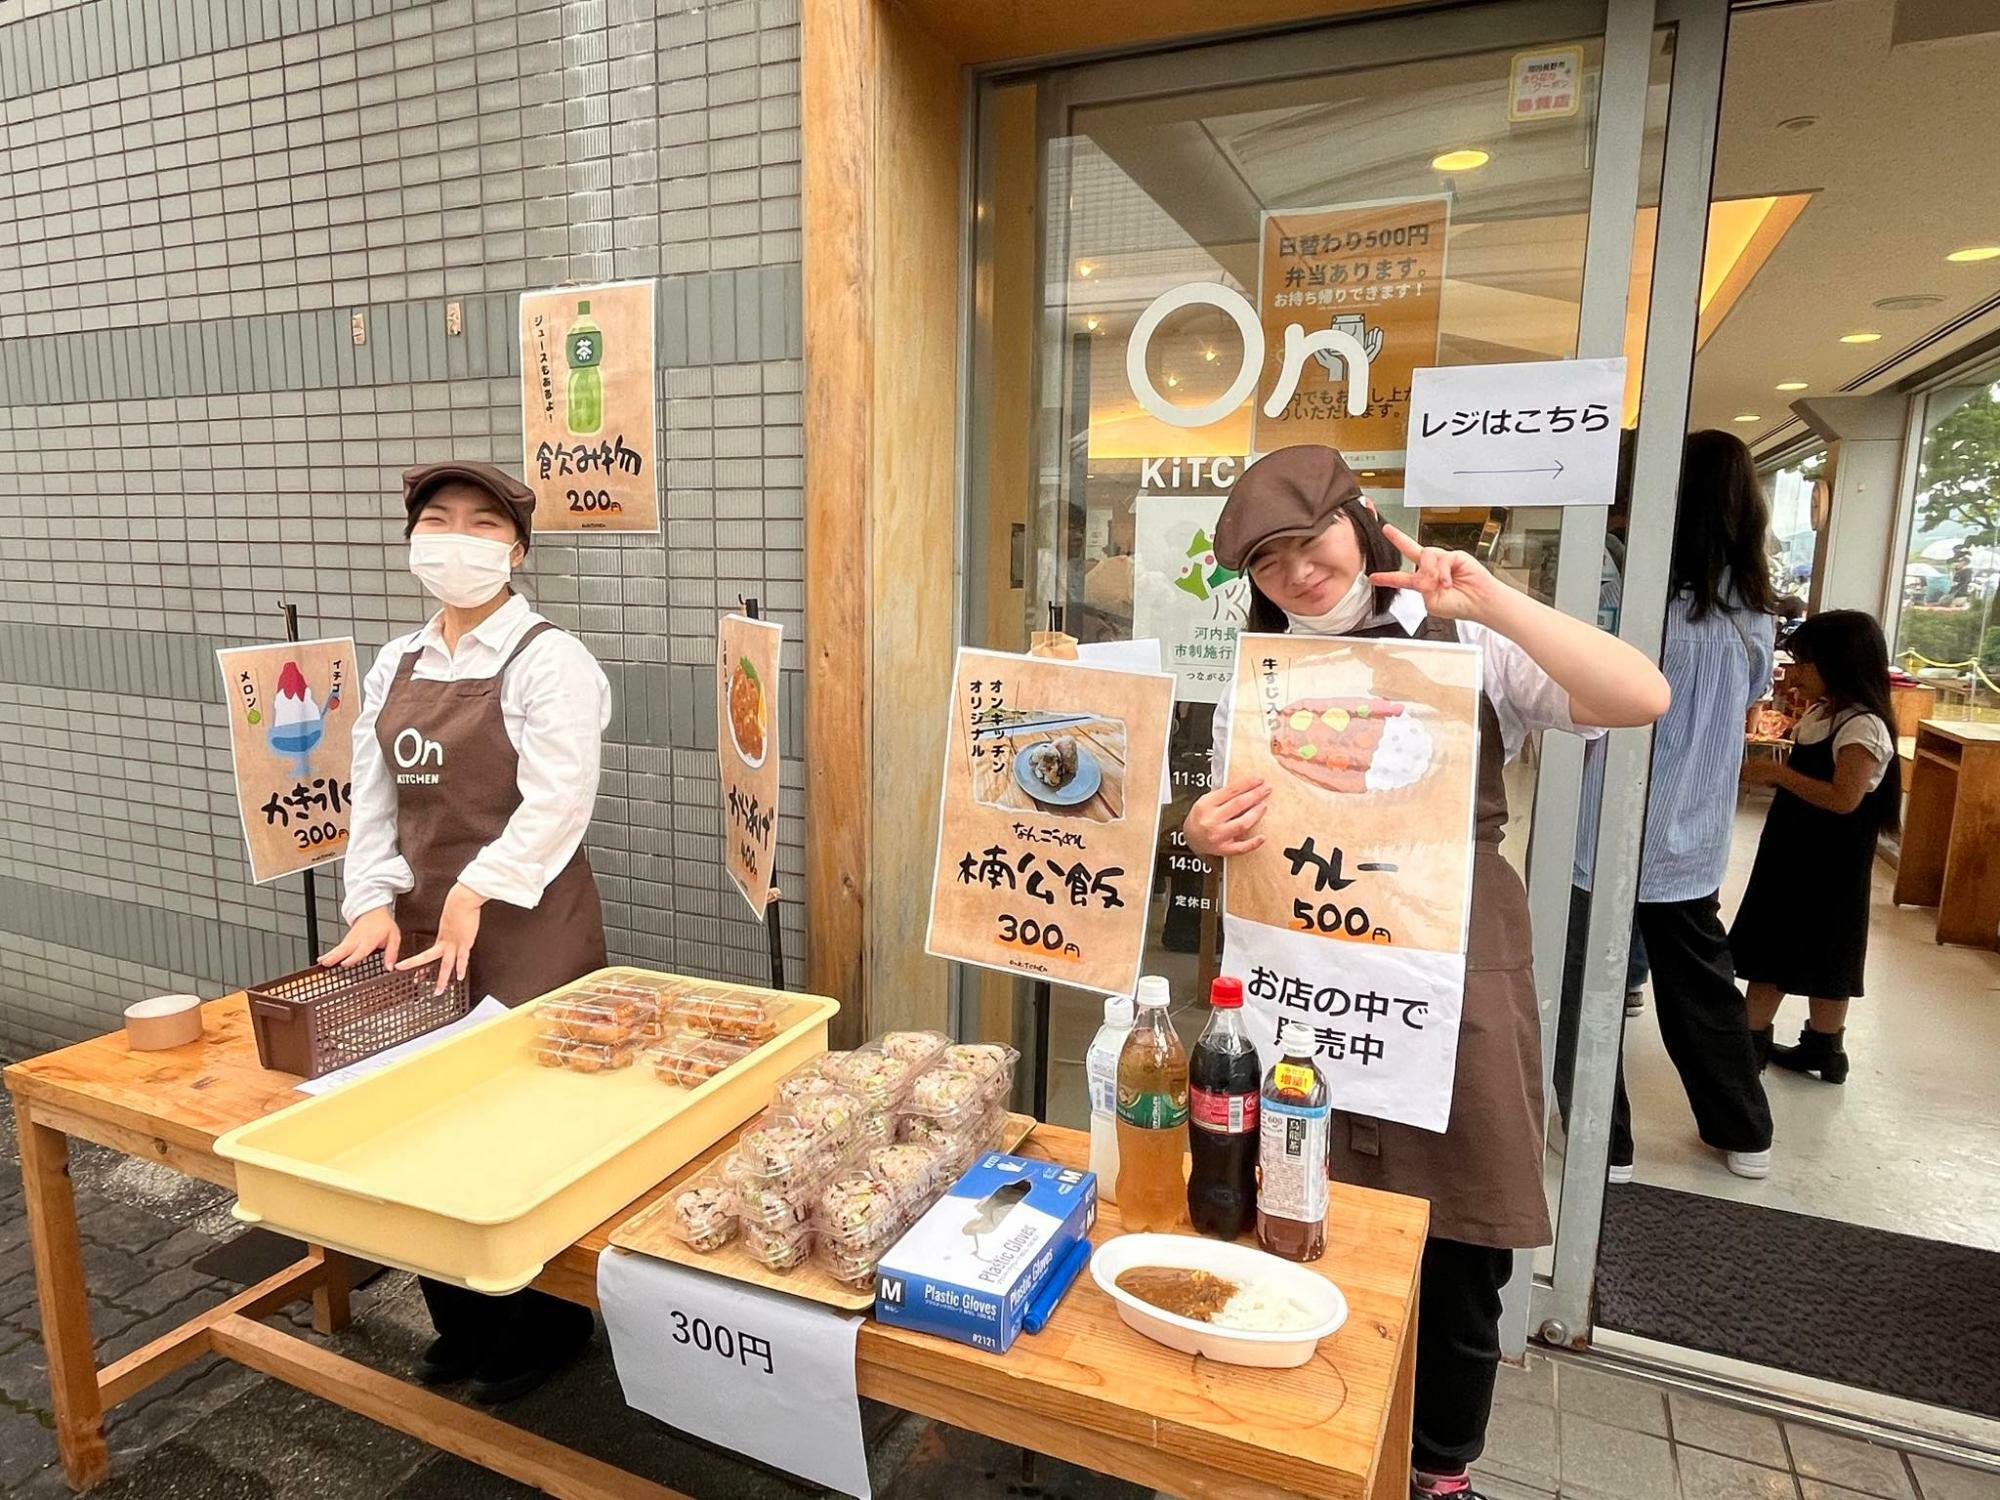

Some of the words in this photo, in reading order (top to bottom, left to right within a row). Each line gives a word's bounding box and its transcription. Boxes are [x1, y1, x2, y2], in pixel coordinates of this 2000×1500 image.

[1279, 224, 1429, 257] 日替わり500円
[1285, 256, 1426, 288] 弁当あります。
[574, 337, 593, 362] 茶
[1127, 281, 1369, 428] On
[1422, 404, 1610, 438] レジはこちら
[536, 434, 642, 481] 飲み物
[566, 489, 623, 513] 200円
[239, 670, 257, 709] メロン
[332, 659, 342, 694] イチゴ
[969, 680, 986, 758] オリジナル
[989, 680, 1006, 774] オンキッチン
[394, 727, 443, 768] On
[294, 821, 349, 848] 300円
[956, 845, 1125, 908] 楠公飯
[1283, 836, 1399, 892] カレー
[1175, 894, 1211, 910] 定休日
[1292, 898, 1391, 943] 500円
[997, 914, 1081, 958] 300円
[1247, 966, 1429, 1030] お店の中で
[1273, 1016, 1385, 1066] 売中
[881, 1278, 902, 1303] M
[924, 1284, 960, 1307] Plastic
[962, 1294, 997, 1316] Gloves
[670, 1310, 774, 1374] 300円
